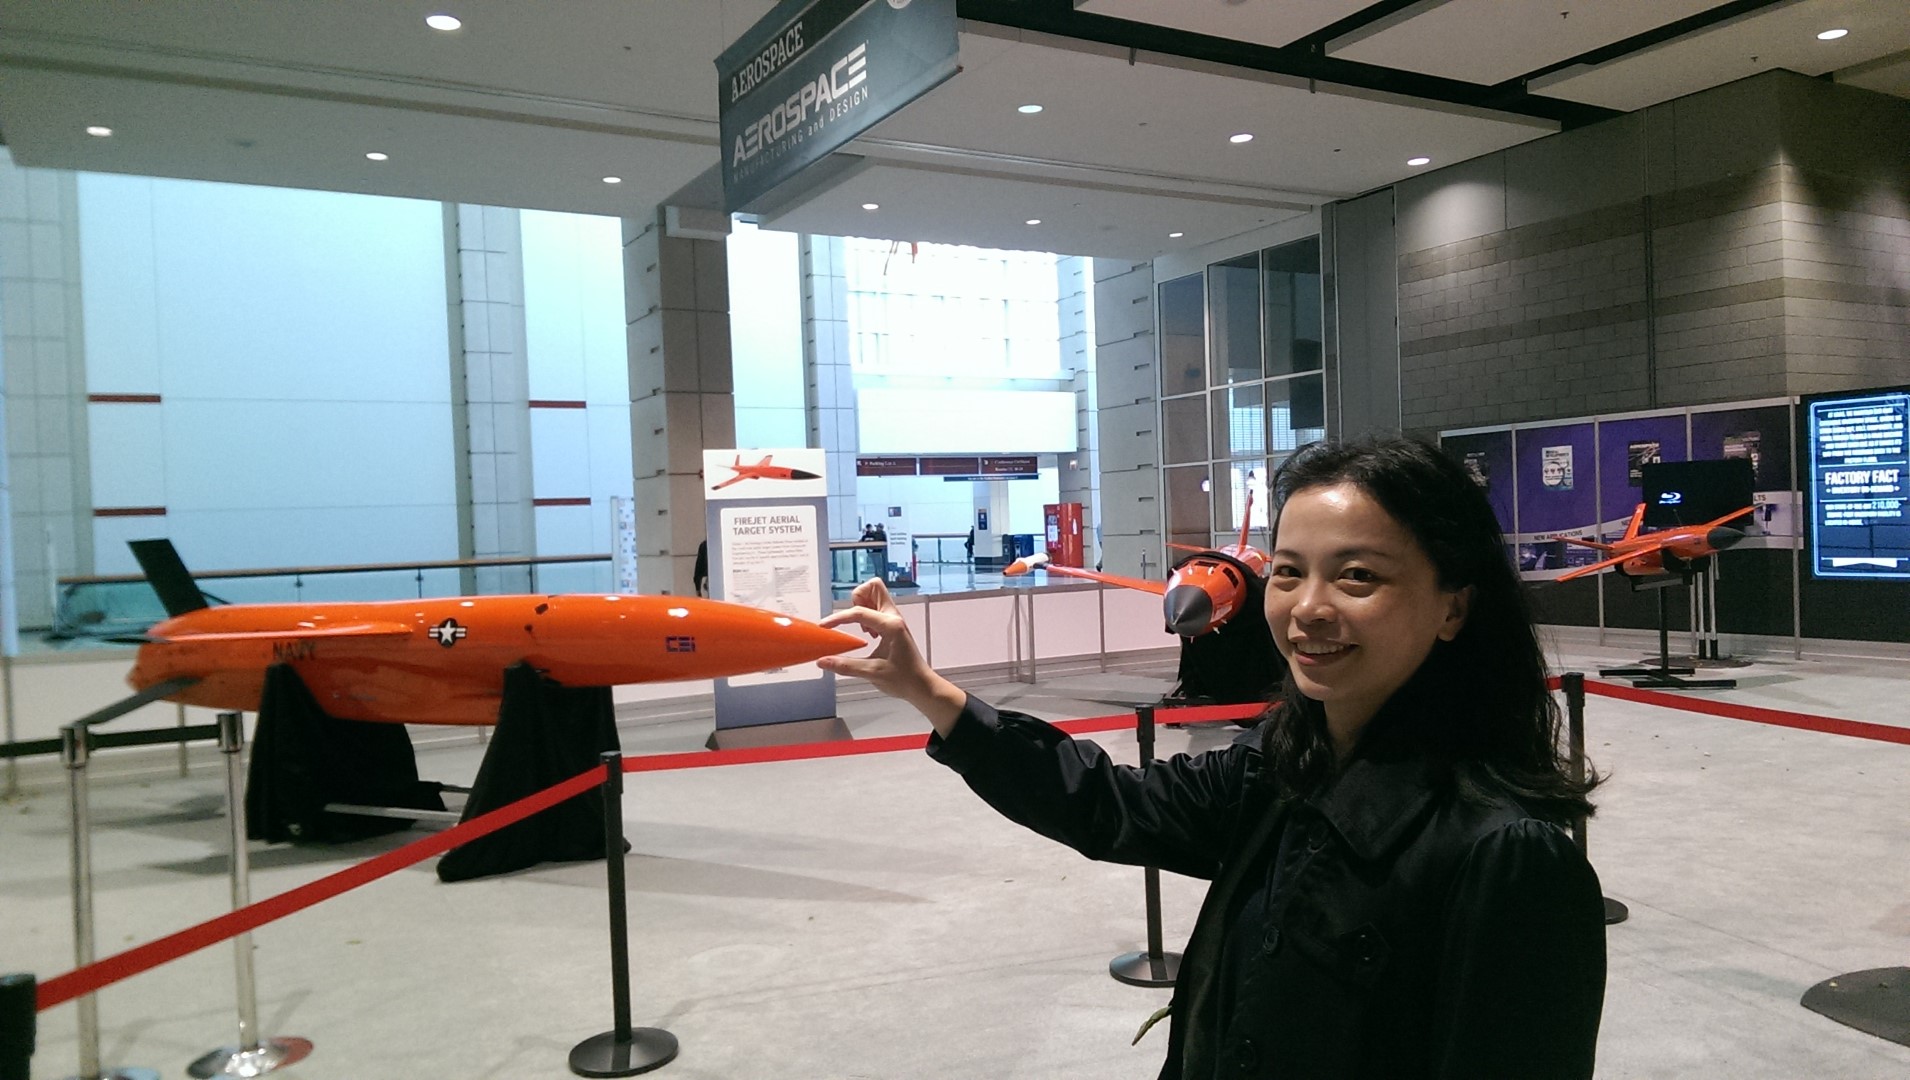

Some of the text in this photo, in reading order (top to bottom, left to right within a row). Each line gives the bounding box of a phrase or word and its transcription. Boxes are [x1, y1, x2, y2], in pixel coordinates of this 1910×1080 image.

[731, 21, 804, 103] AEROSPACE
[733, 42, 867, 168] AEROSPACE
[808, 115, 824, 136] and
[830, 85, 868, 122] DESIGN
[1825, 469, 1900, 485] FACTORY FACT
[733, 525, 802, 535] TARGET SYSTEM
[734, 515, 800, 525] FIREJET AERIAL
[272, 641, 317, 661] NAVY
